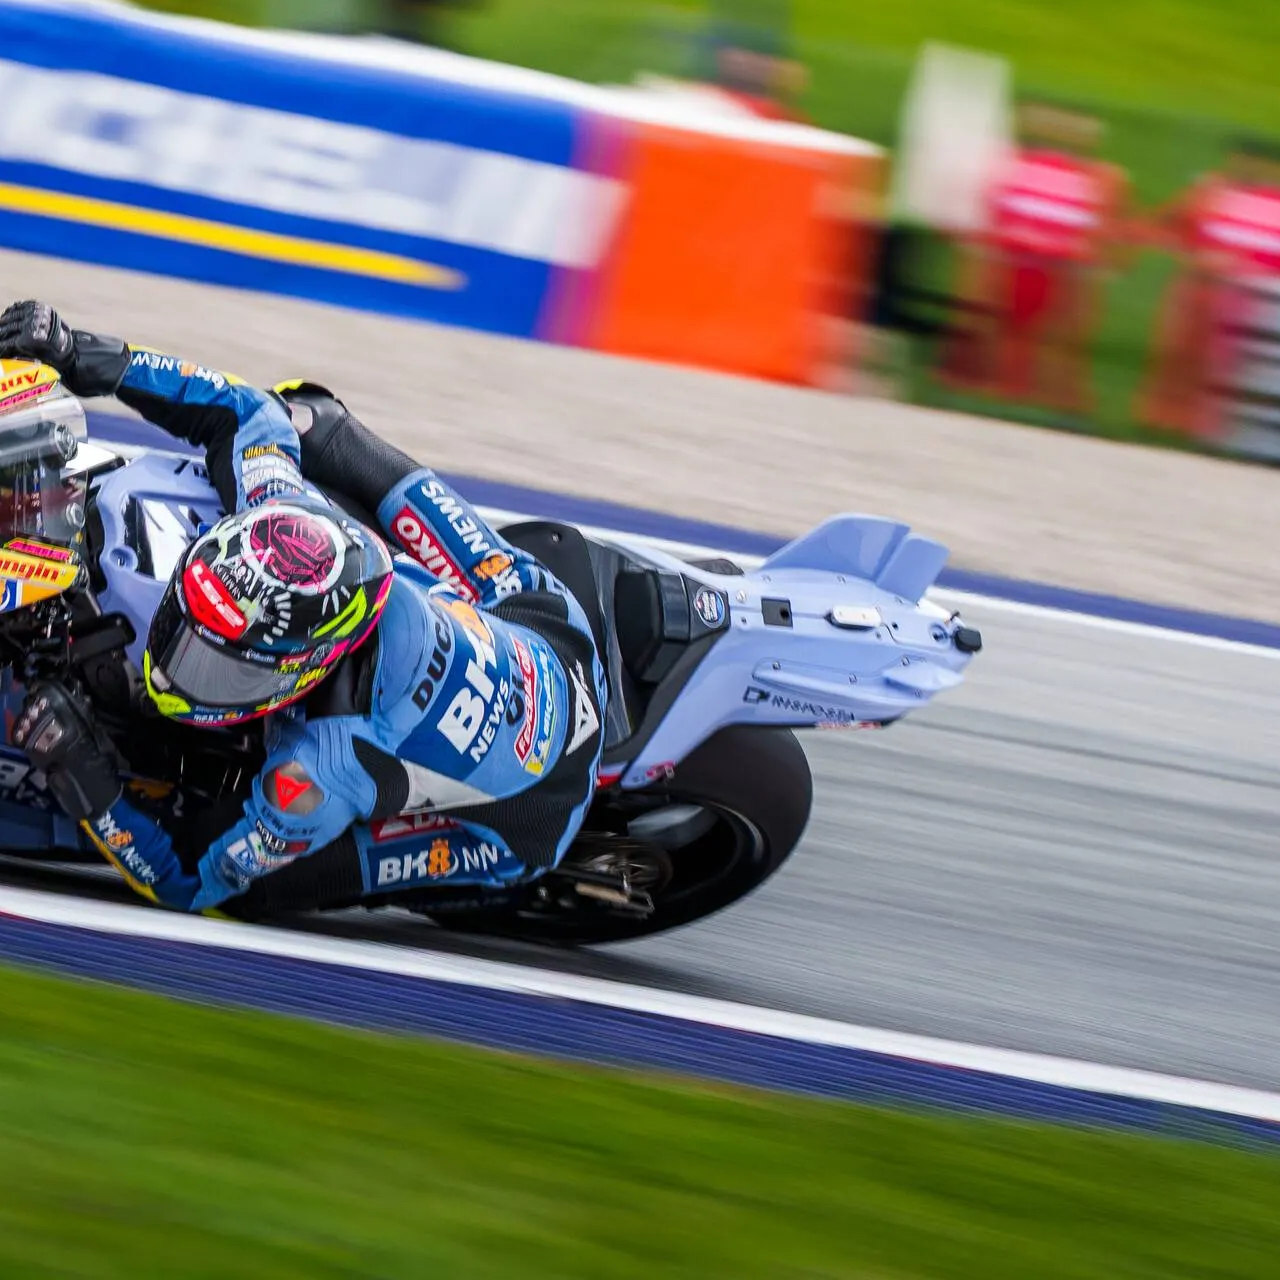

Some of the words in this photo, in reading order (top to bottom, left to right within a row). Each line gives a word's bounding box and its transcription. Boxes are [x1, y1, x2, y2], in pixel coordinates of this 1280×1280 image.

[132, 351, 173, 371] NEW
[421, 480, 491, 554] NEWS
[411, 617, 452, 713] DUC
[470, 676, 510, 763] NEWS
[378, 837, 459, 885] BK8
